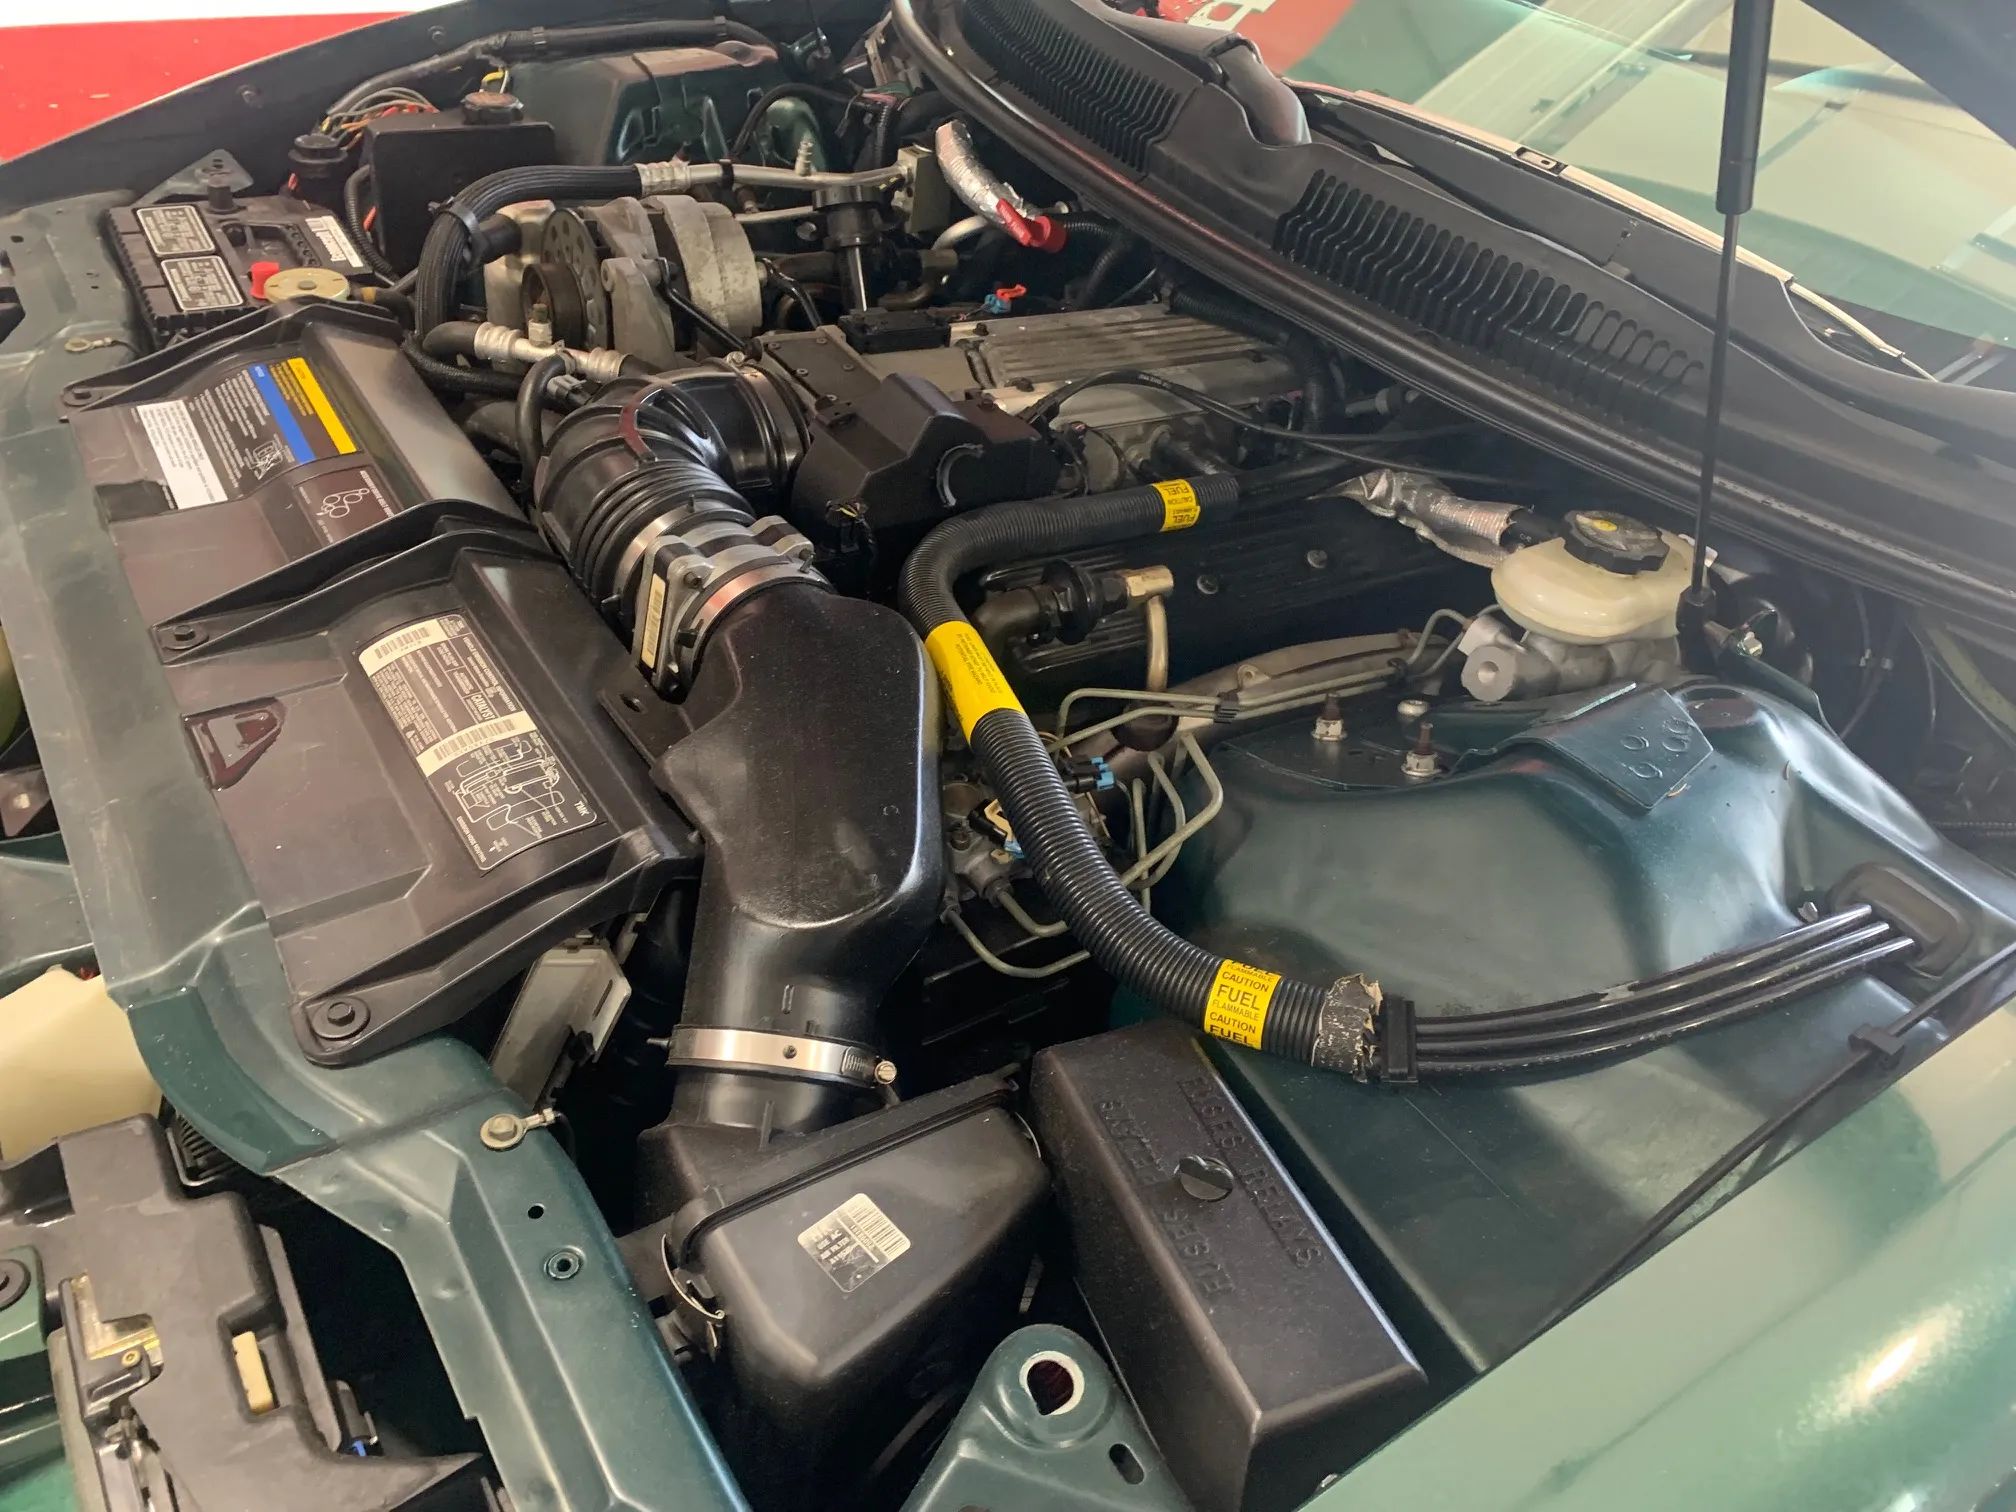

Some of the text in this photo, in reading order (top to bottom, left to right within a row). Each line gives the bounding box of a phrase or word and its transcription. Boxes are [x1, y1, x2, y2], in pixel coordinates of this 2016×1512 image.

[471, 694, 496, 719] CATALYST
[1222, 971, 1269, 992] CAUTION
[1217, 984, 1260, 1011] FUEL
[1212, 999, 1259, 1021] FLAMMABLE
[1209, 1011, 1256, 1034] CAUTION
